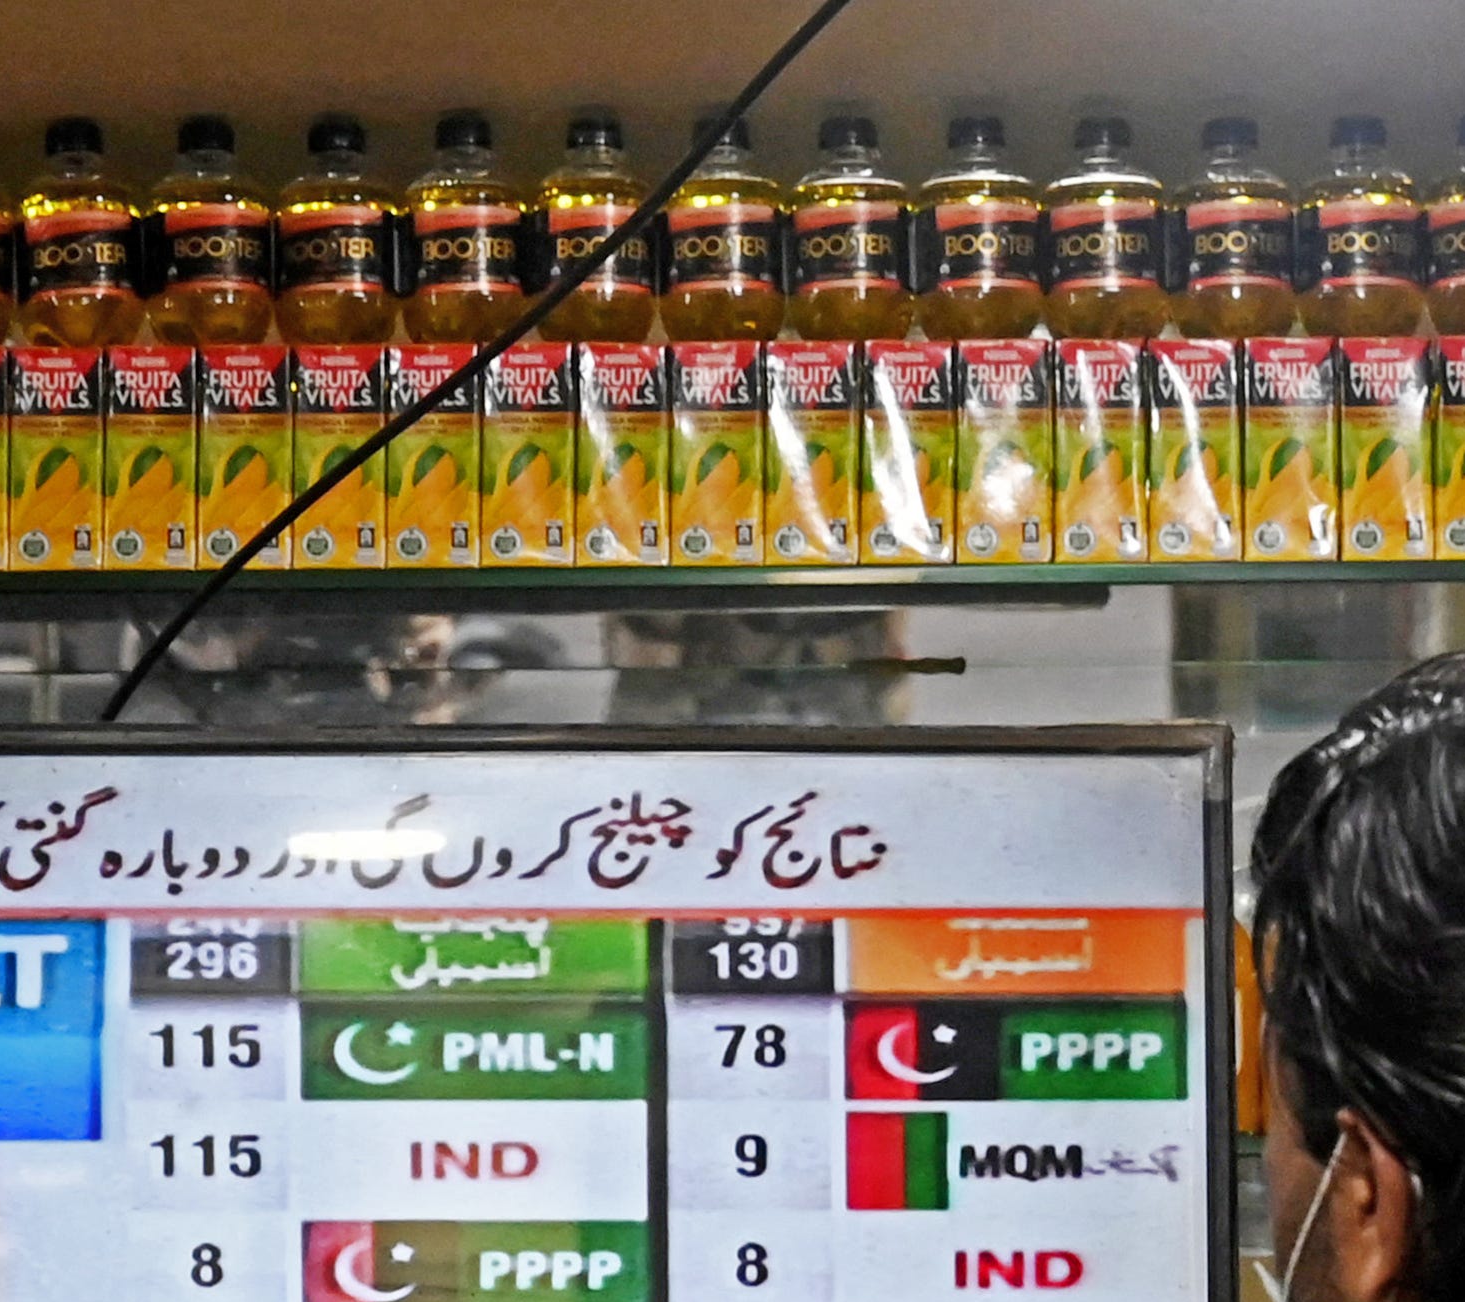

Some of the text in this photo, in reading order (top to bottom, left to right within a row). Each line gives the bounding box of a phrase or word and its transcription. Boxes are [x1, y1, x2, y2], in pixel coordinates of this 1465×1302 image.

[99, 829, 249, 895] دوبارہ
[422, 807, 601, 889] کروں
[587, 792, 692, 889] چیلنج
[707, 805, 775, 880] کو
[762, 792, 887, 889] نتائج
[166, 942, 258, 978] 296
[393, 945, 551, 989] اسمبلی
[709, 942, 799, 979] 130
[150, 1024, 262, 1068] 115
[442, 1032, 615, 1071] PML-N
[715, 1024, 787, 1067] 78
[1020, 1032, 1162, 1071] PPPP
[150, 1134, 262, 1178] 115
[409, 1141, 539, 1180] IND
[734, 1134, 768, 1178] 9
[958, 1144, 1083, 1181] MQM
[190, 1243, 223, 1287] 8
[479, 1250, 622, 1290] PPPP
[736, 1243, 769, 1287] 8
[954, 1250, 1083, 1290] IND
